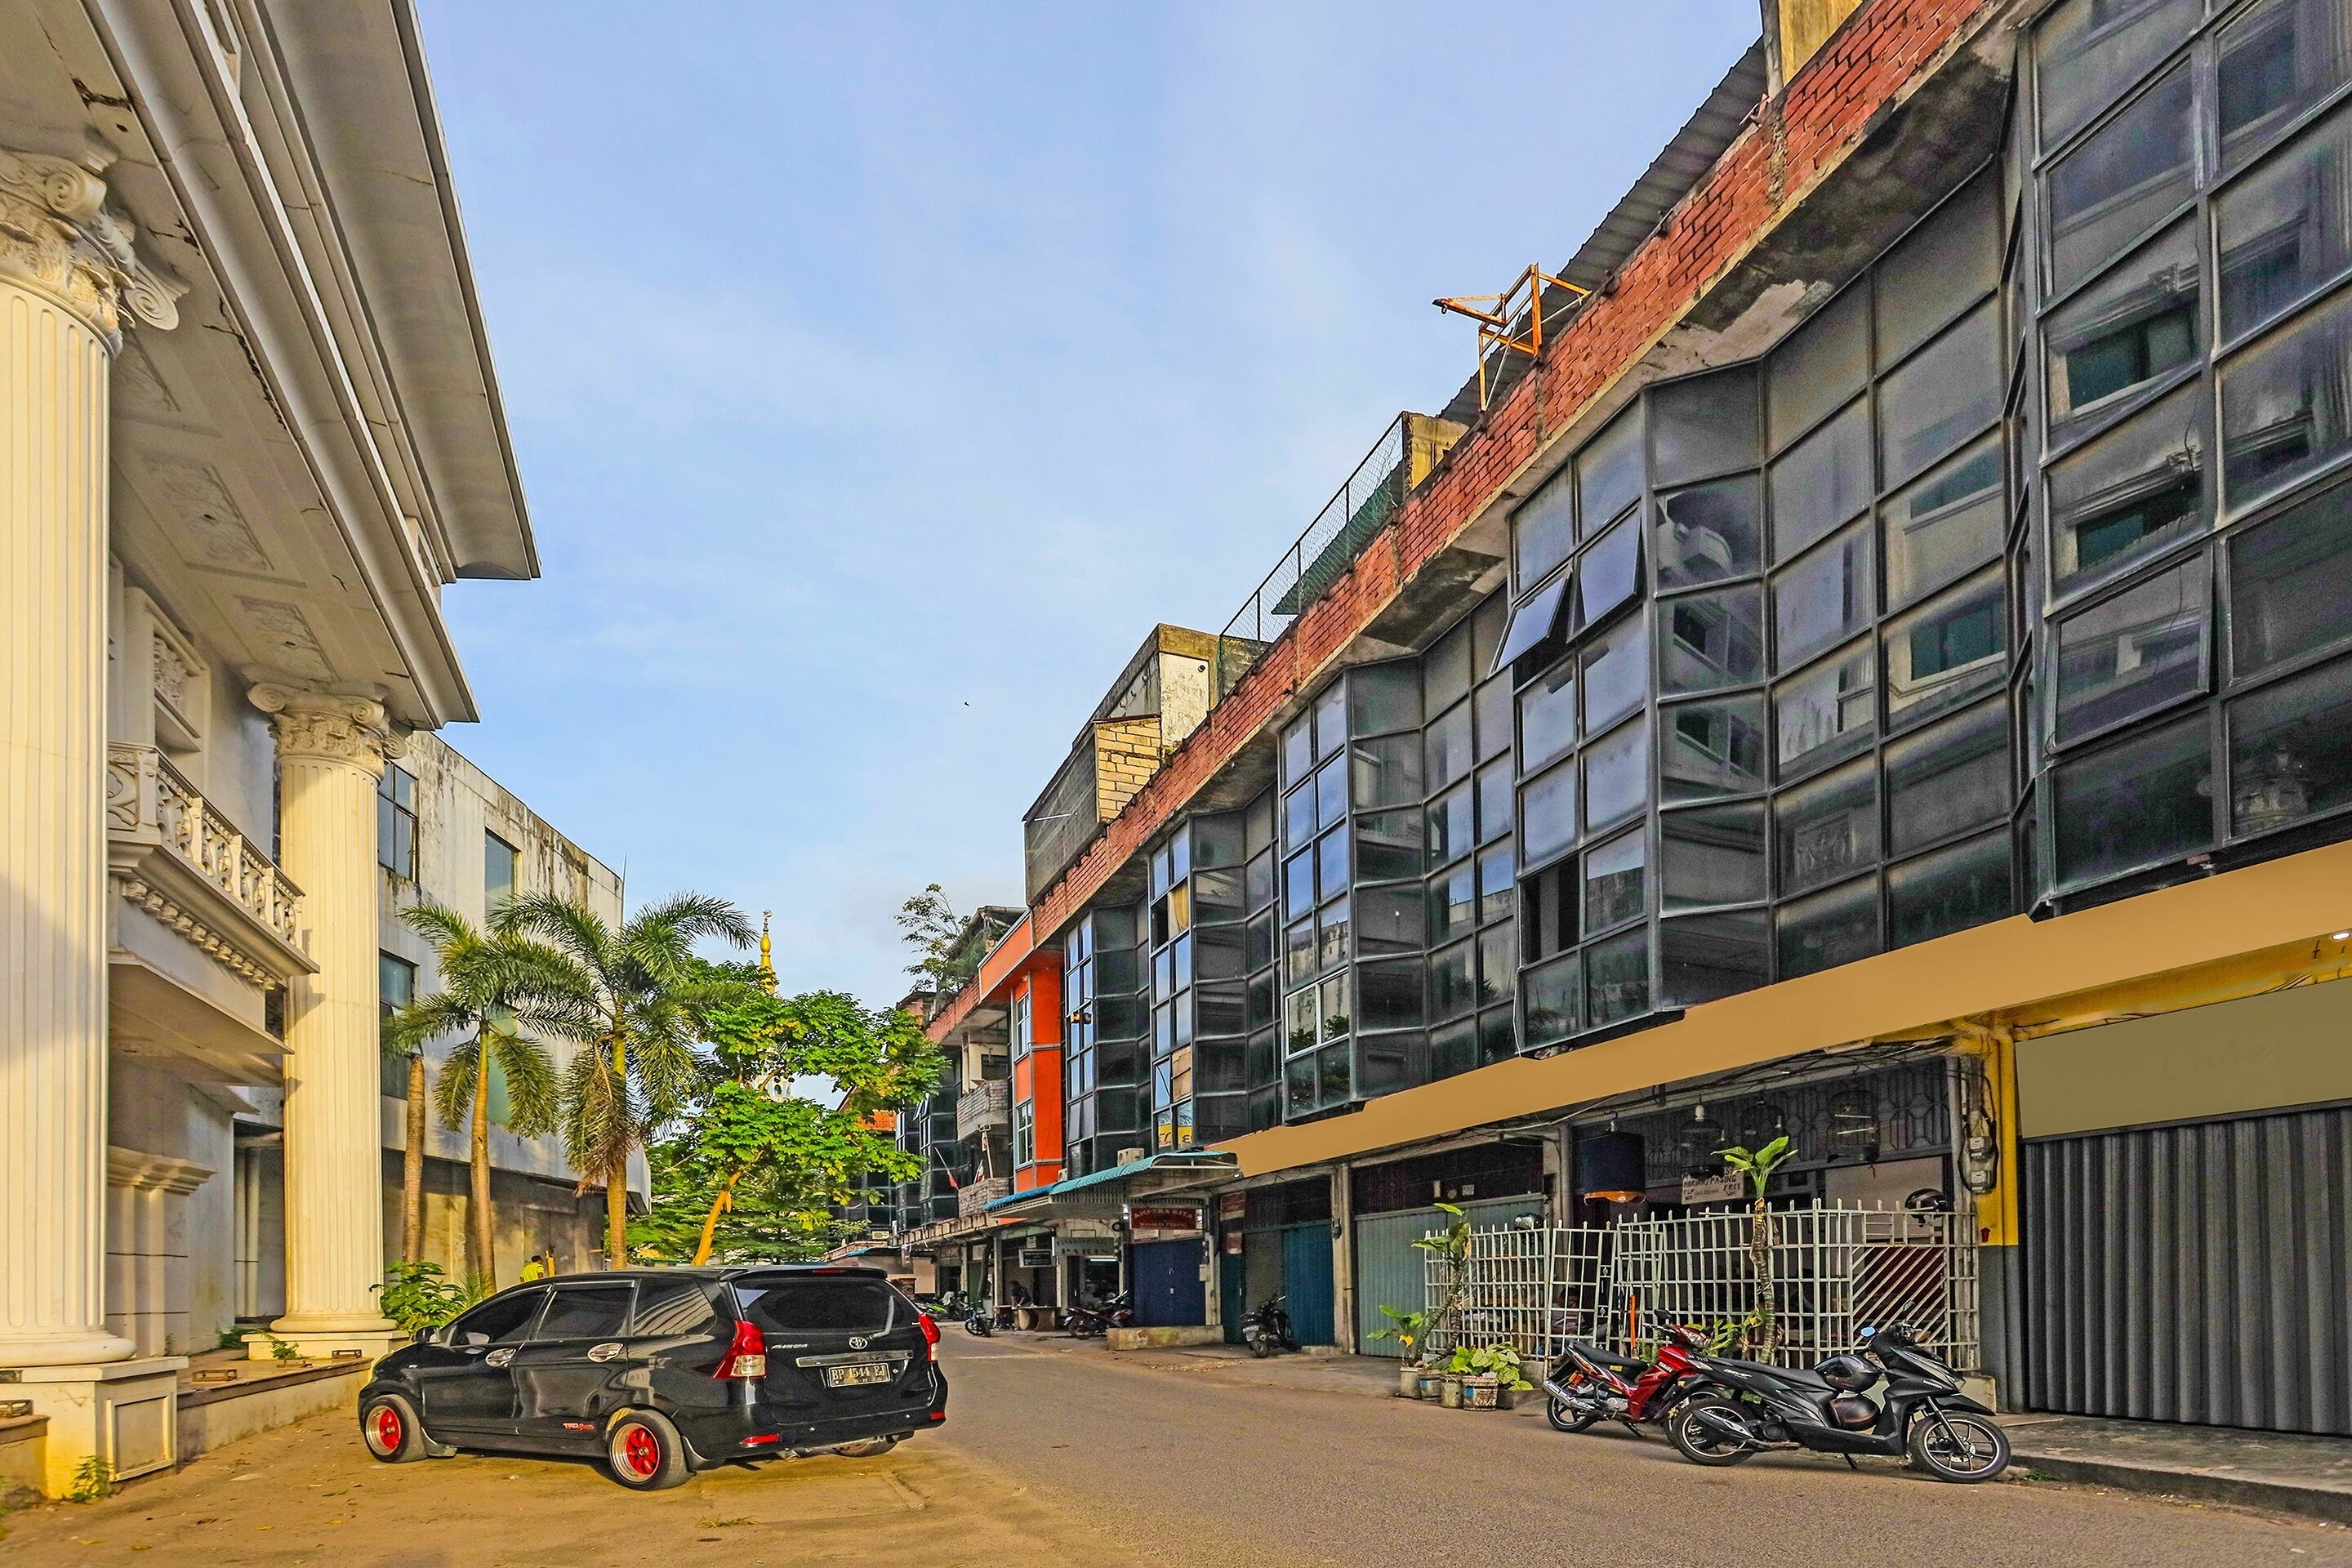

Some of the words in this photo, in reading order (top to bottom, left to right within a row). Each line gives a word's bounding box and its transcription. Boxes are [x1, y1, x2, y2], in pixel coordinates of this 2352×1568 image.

[1723, 1183, 1741, 1192] FREE
[1134, 1209, 1170, 1219] AMPERA
[1172, 1209, 1192, 1219] KITA
[1658, 1361, 1673, 1373] YAMAHA
[831, 1369, 844, 1380] BP
[849, 1367, 871, 1378] 1544
[874, 1365, 886, 1376] EJ
[1922, 1379, 1943, 1389] HONDA
